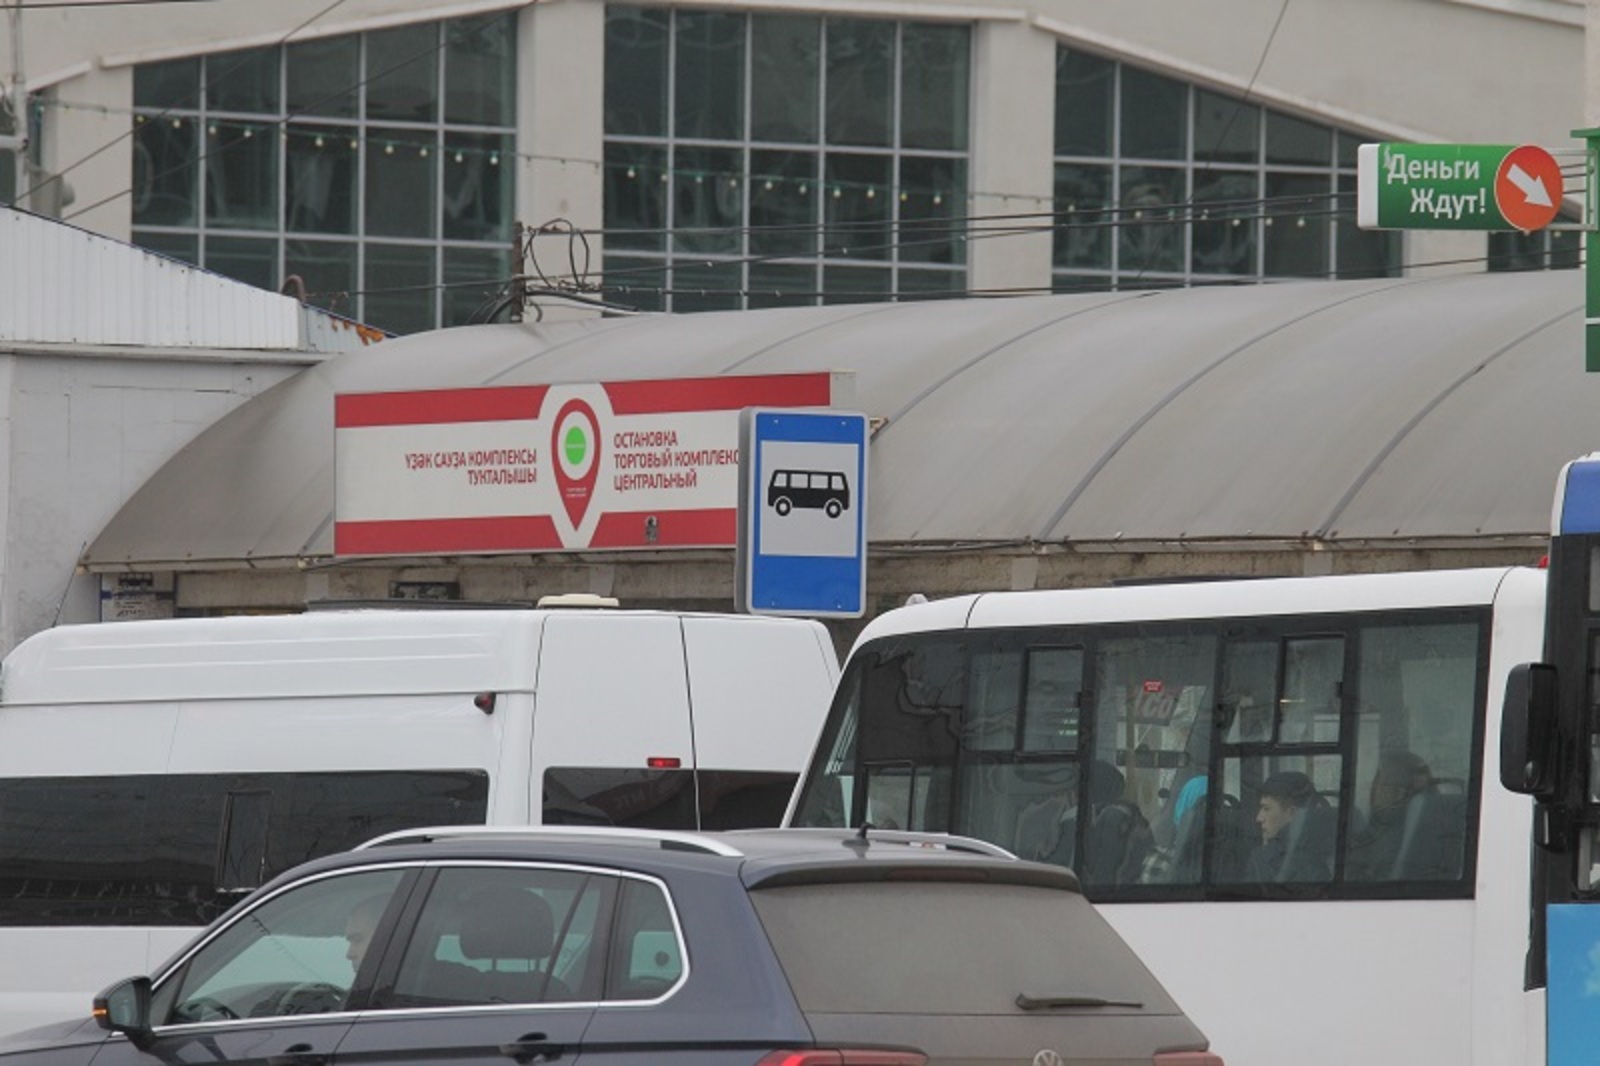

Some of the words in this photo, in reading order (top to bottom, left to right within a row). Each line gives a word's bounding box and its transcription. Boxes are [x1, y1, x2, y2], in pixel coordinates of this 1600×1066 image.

[1387, 153, 1480, 185] Деньги
[1410, 187, 1487, 220] Ждут!
[613, 430, 678, 449] ОСТАНОВКА
[468, 448, 537, 468] КОМПЛЕКСЫ
[613, 448, 672, 469] ТОРГОВЫЙ
[674, 449, 739, 467] КОМПЛЕКС
[613, 467, 697, 492] ЦЕНТРАЛЬНЫЙ
